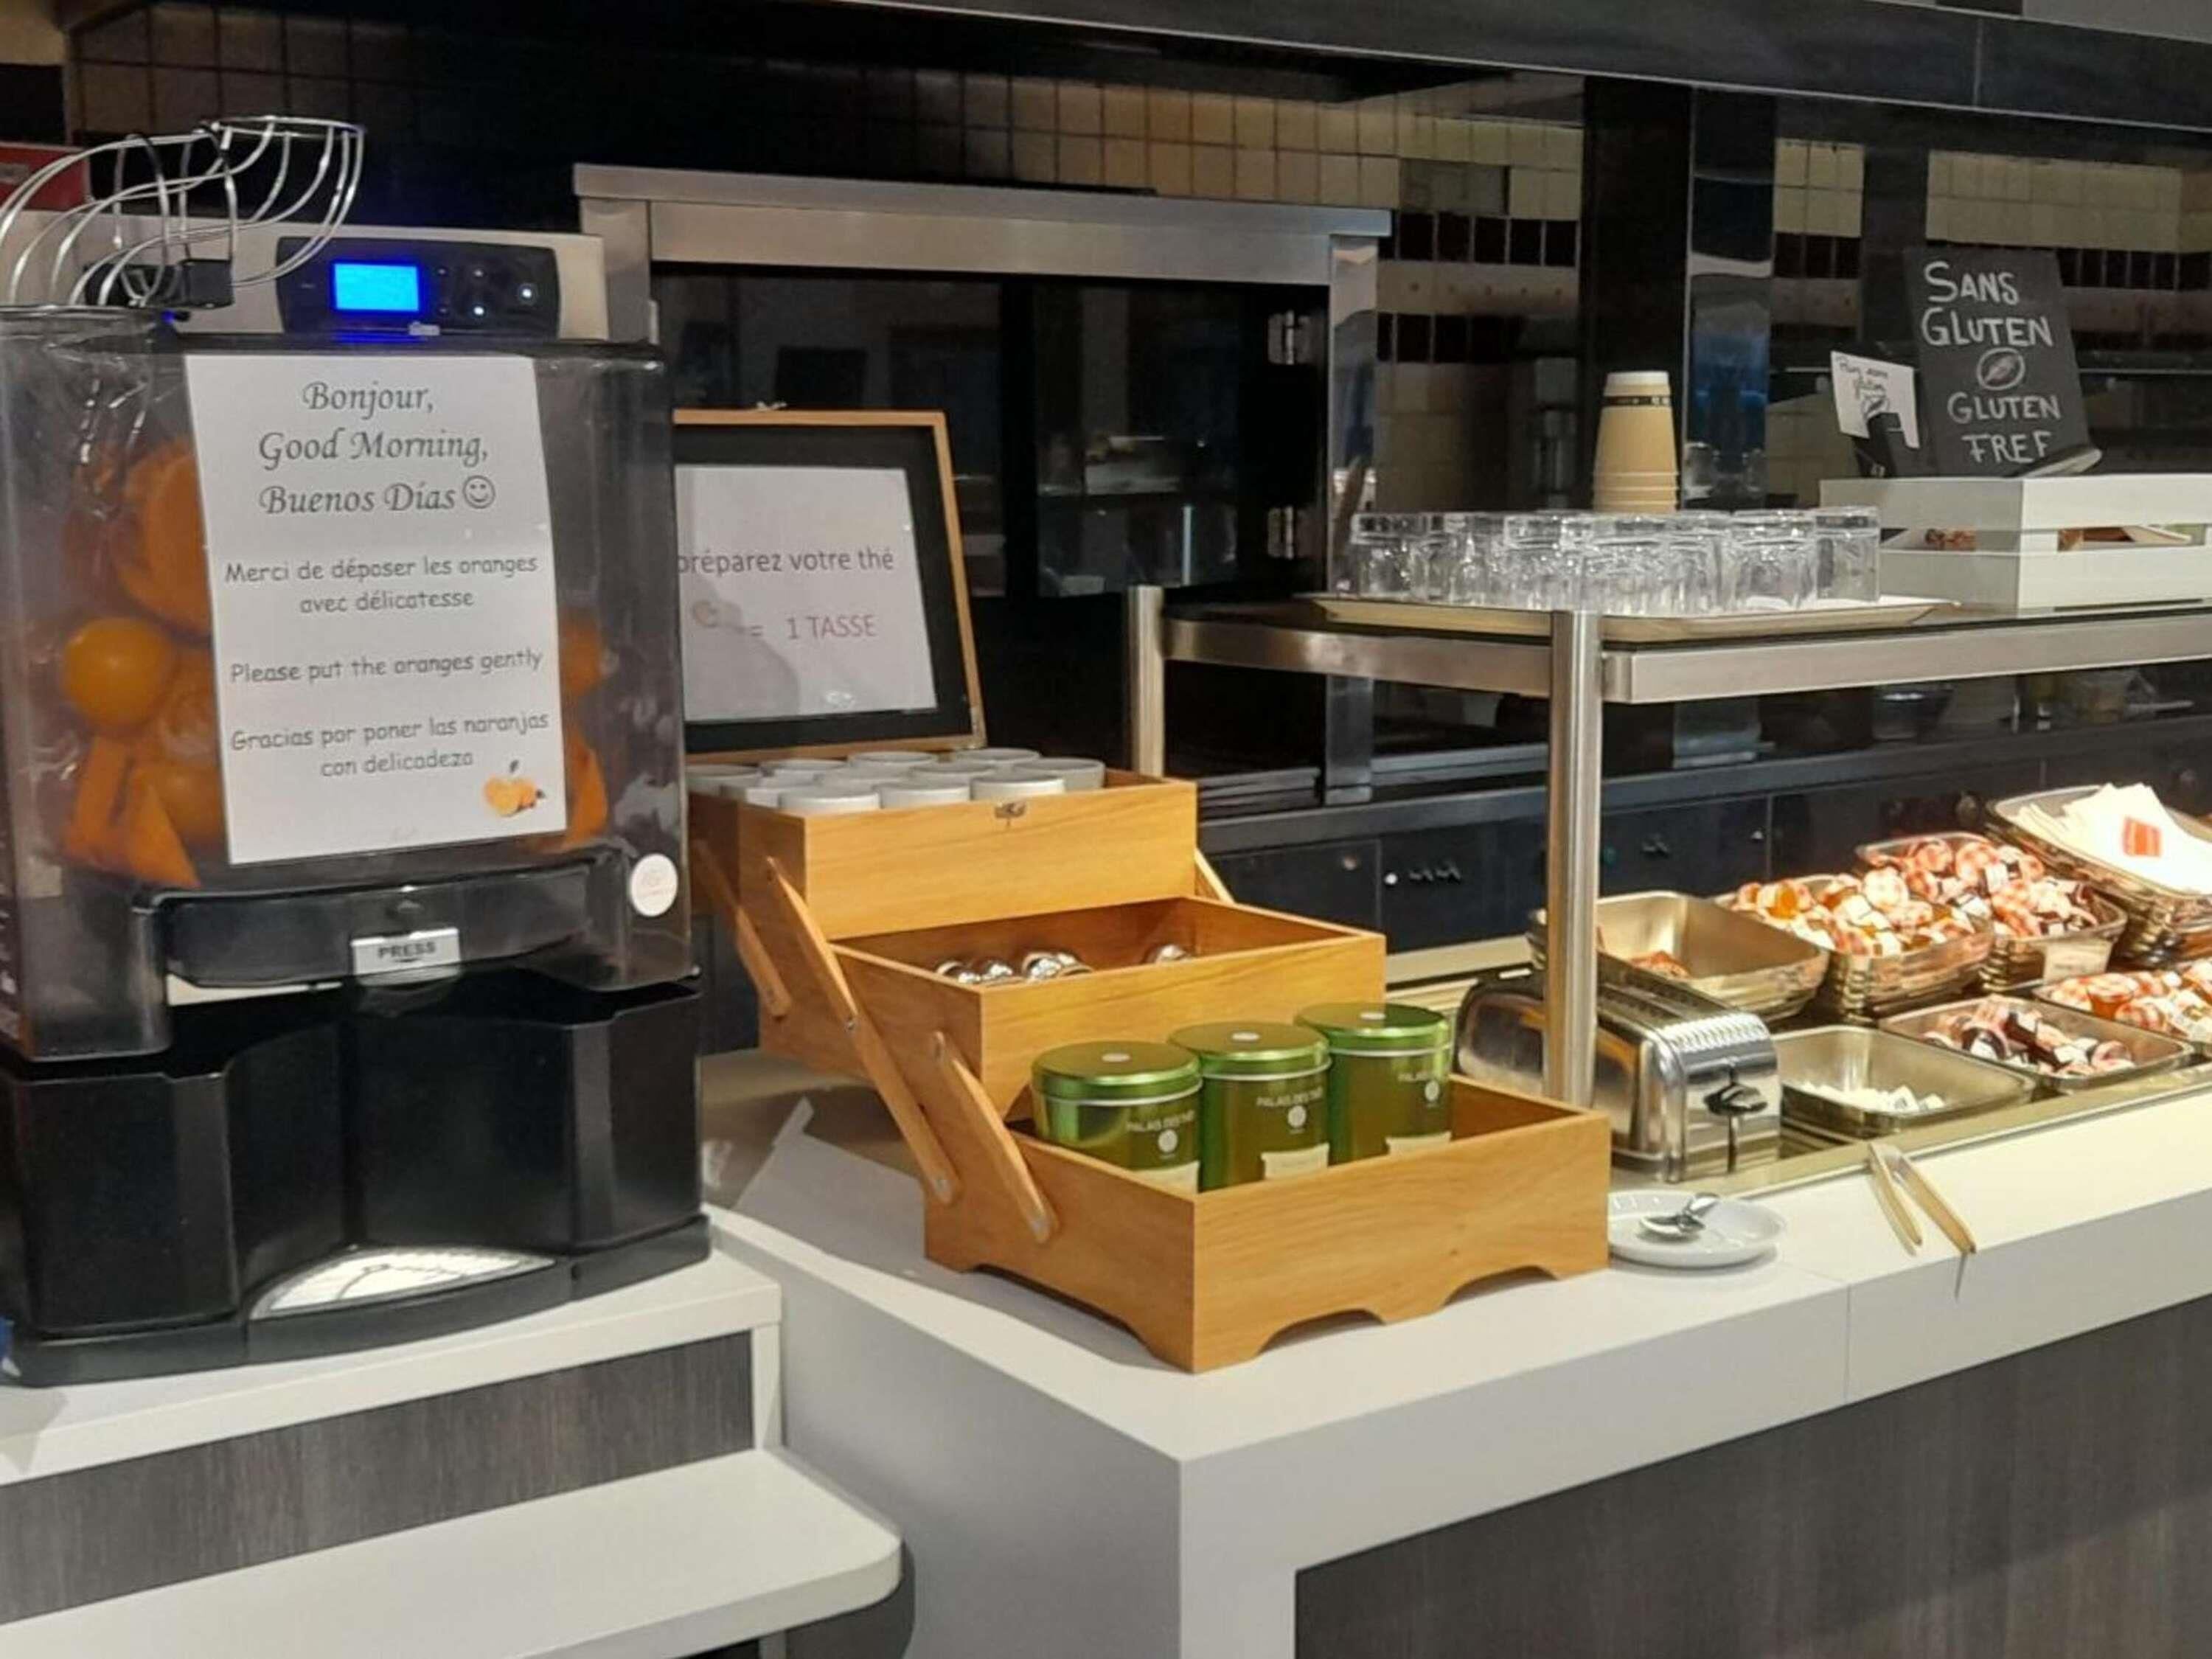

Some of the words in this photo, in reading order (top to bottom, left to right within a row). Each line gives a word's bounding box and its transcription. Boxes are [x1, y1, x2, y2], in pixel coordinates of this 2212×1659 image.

[1924, 261, 2020, 305] SANS
[1921, 307, 2053, 347] GLUTEN
[302, 380, 434, 419] Bonjour,
[1947, 391, 2061, 423] GLUTEN
[259, 428, 345, 470] Good
[349, 429, 489, 467] Morning,
[259, 483, 375, 515] Buenos
[383, 480, 456, 512] Días
[224, 561, 290, 583] Merci
[296, 560, 325, 580] de
[331, 557, 416, 582] déposer
[423, 556, 453, 576] les
[459, 555, 539, 579] oranges
[787, 550, 852, 571] votre
[858, 545, 894, 571] thé
[299, 596, 348, 614] avec
[355, 590, 476, 613] délicatesse
[787, 617, 800, 639] 1
[806, 615, 877, 639] TASSE
[230, 662, 302, 683] Please
[307, 661, 342, 684] put
[351, 658, 387, 676] the
[394, 653, 474, 677] oranges
[481, 647, 543, 675] gently
[231, 728, 313, 751] Gracias
[320, 727, 356, 748] por
[363, 723, 423, 745] poner
[428, 717, 456, 737] las
[463, 713, 550, 738] naranjas
[319, 759, 358, 777] con
[364, 750, 474, 775] delicadeza
[378, 941, 437, 959] PRESS
